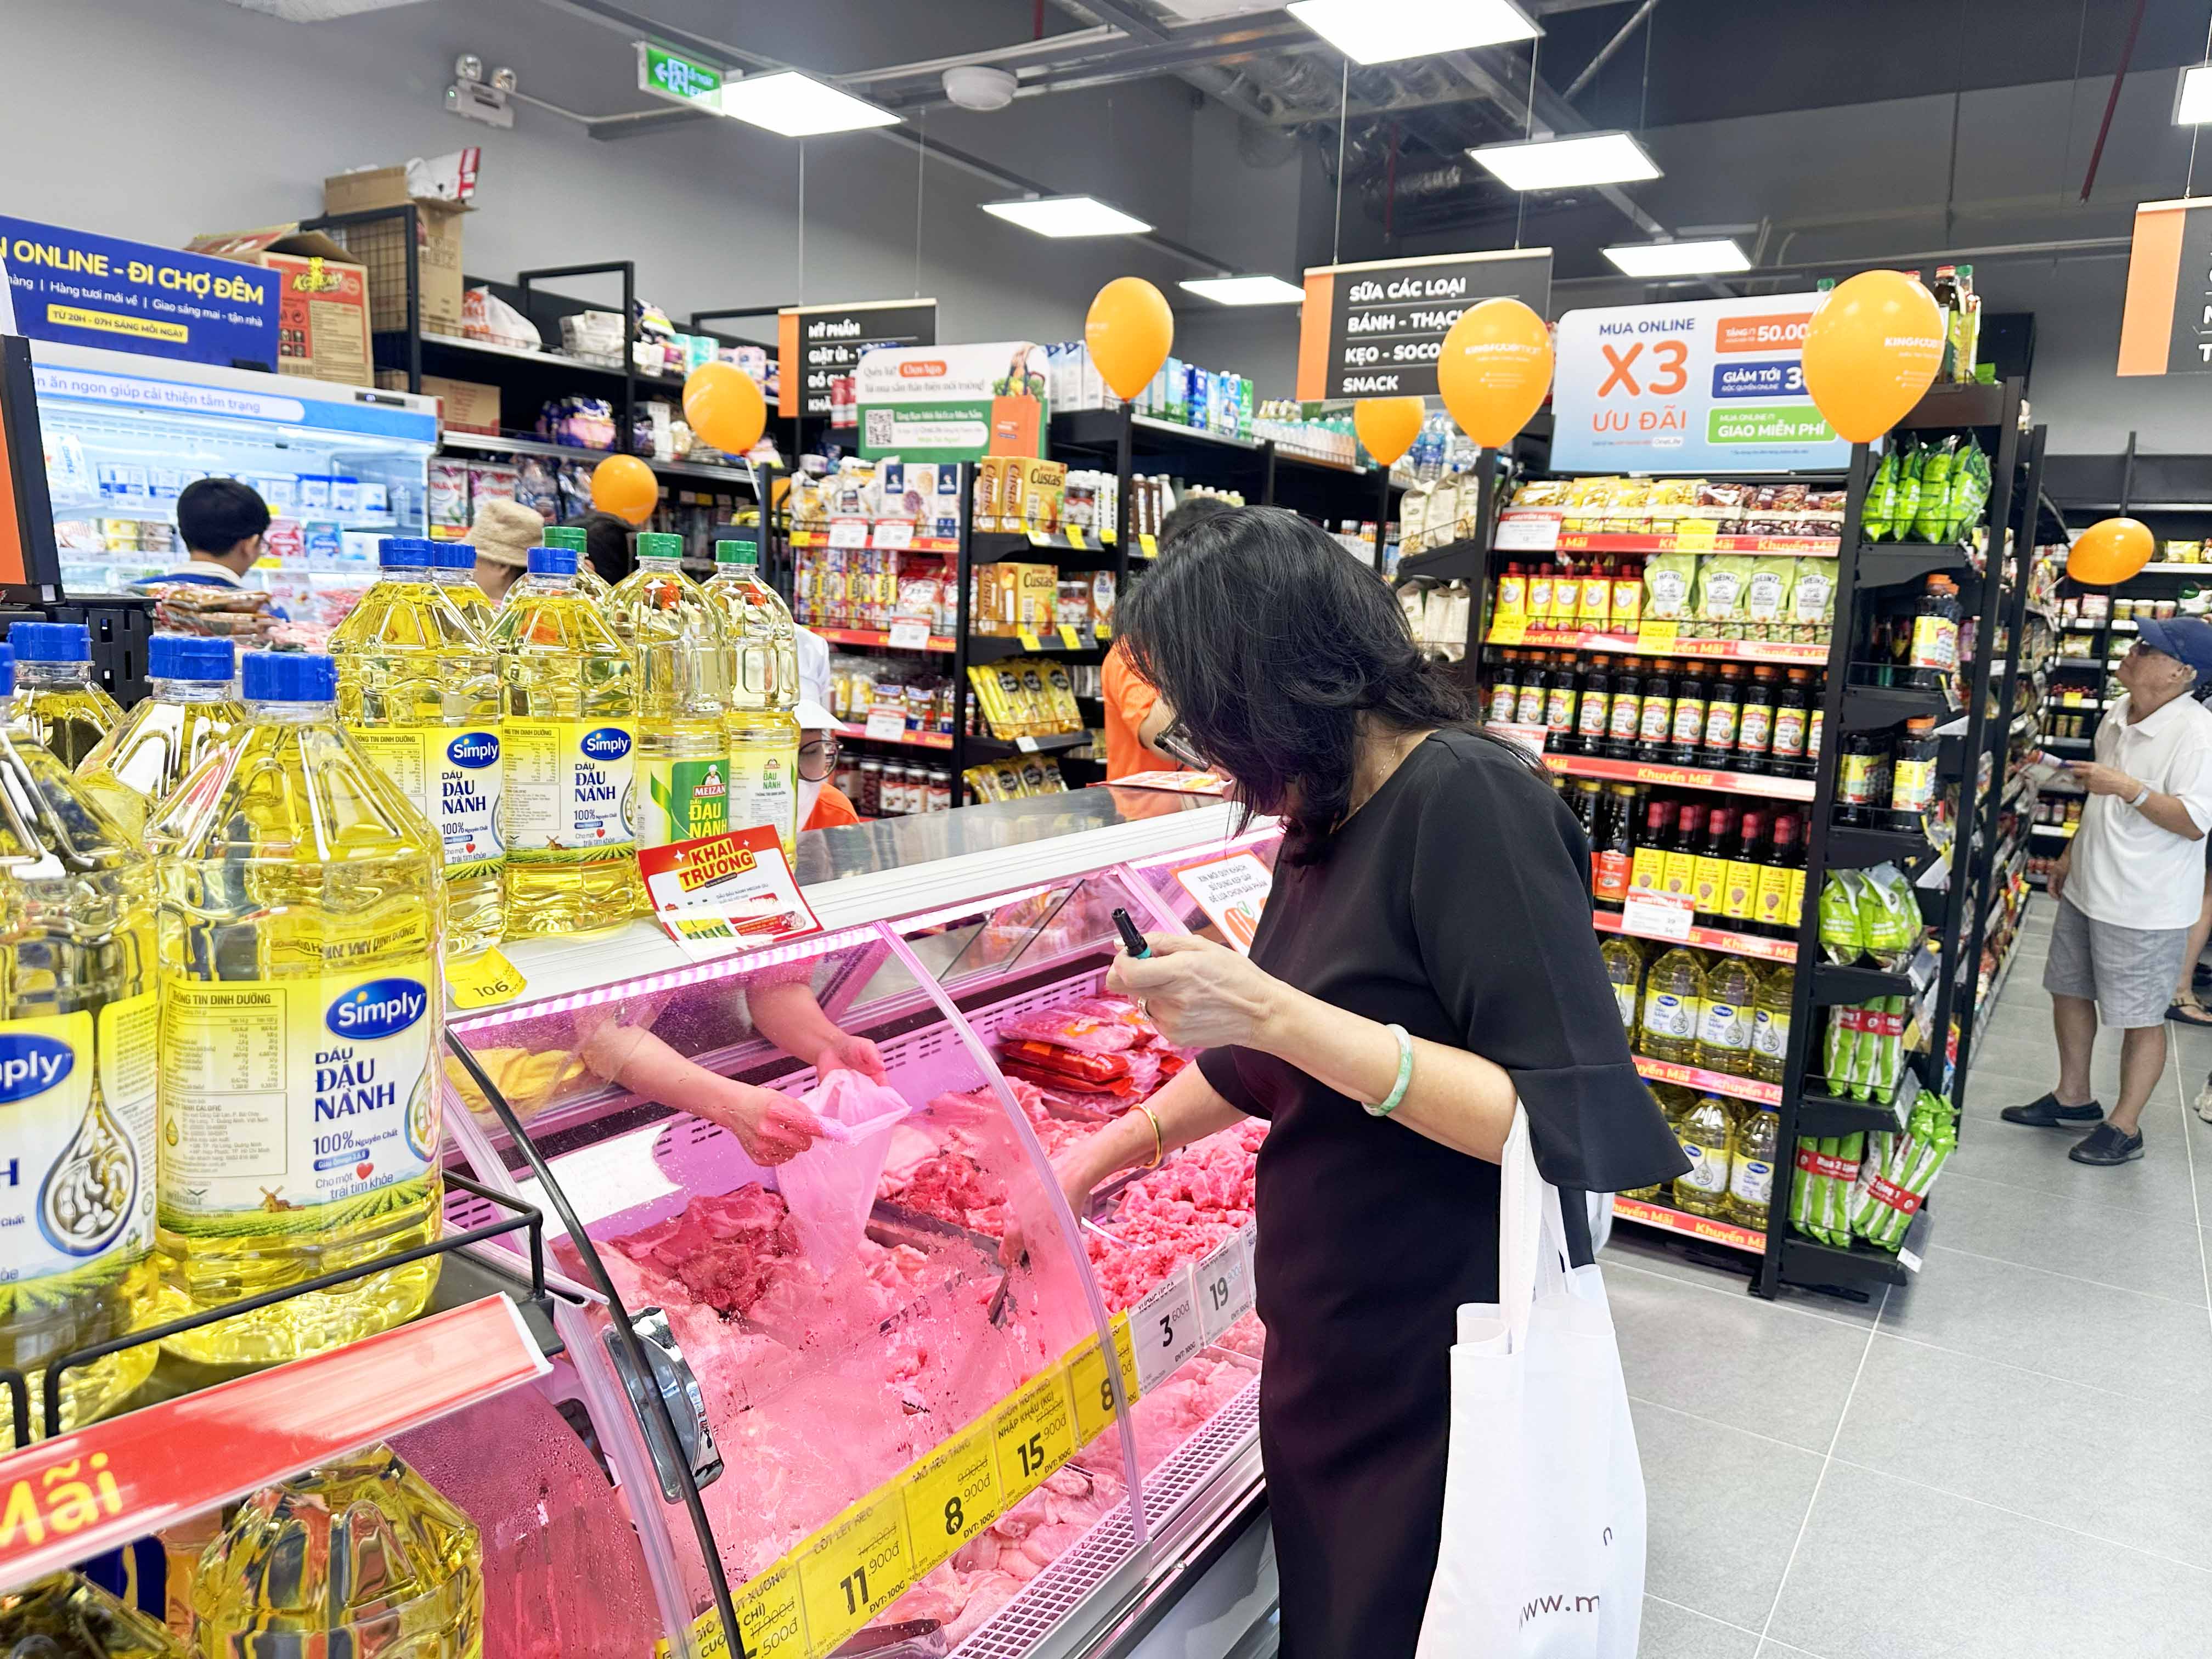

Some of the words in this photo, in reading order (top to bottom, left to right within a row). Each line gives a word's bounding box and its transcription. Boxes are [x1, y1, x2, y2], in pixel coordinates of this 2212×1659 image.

[14, 240, 109, 276] ONLINE
[127, 261, 154, 285] ĐI
[158, 267, 211, 300] CHỢ
[213, 275, 263, 306] ĐÊM
[50, 281, 80, 298] Hàng
[152, 298, 176, 312] Giao
[177, 303, 200, 318] sáng
[1350, 281, 1383, 302] SỮA
[1387, 277, 1423, 298] CÁC
[1426, 276, 1466, 298] LOẠI
[1347, 312, 1395, 332] BÁNH
[1409, 309, 1463, 330] THẠC
[1599, 323, 1633, 335] MUA
[1638, 318, 1695, 333] ONLINE
[1757, 323, 1808, 342] 50.00
[1345, 347, 1379, 366] KẸO
[1393, 342, 1441, 360] SOCO
[1598, 340, 1688, 397] X3
[1723, 368, 1756, 383] GIẢM
[1759, 367, 1781, 382] TỚI
[1785, 367, 1805, 390] 3
[1342, 375, 1398, 393] SNACK
[72, 382, 106, 395] ngon
[111, 385, 140, 400] giúp
[144, 388, 162, 400] cải
[165, 391, 198, 405] thiện
[228, 398, 261, 414] trạng
[1593, 409, 1629, 432] ƯU
[1639, 405, 1686, 430] ĐÃI
[1718, 424, 1755, 438] GIAO
[1758, 419, 1796, 437] MIỄN
[1798, 419, 1826, 436] PHÍ
[1031, 468, 1061, 487] Custas
[1565, 537, 1589, 548] Mãi
[1524, 632, 1552, 644] uyến
[454, 738, 498, 759] Simply
[586, 733, 628, 753] Simply
[1546, 758, 1568, 769] Mãi
[1637, 768, 1685, 783] Khuyến
[1688, 772, 1713, 785] Mãi
[442, 794, 486, 815] NÀNH
[575, 785, 616, 802] NÀNH
[574, 810, 595, 821] 100%
[688, 802, 721, 821] ĐẬU
[442, 822, 464, 835] 100%
[691, 840, 734, 866] KHAI
[679, 851, 753, 887] TRƯƠNG
[1775, 946, 1796, 958] Mã
[193, 995, 208, 1004] TIN
[211, 995, 234, 1005] DINH
[236, 992, 270, 1004] DƯỠNG
[473, 980, 509, 997] 106
[338, 991, 421, 1027] Simply
[0, 1049, 62, 1089] ply
[315, 1057, 375, 1092] ĐẬU
[1667, 1069, 1690, 1082] Mãi
[314, 1080, 396, 1122] NÀNH
[313, 1130, 354, 1155] 100%
[355, 1134, 381, 1148] Nguyên
[382, 1128, 398, 1141] Chất
[316, 1176, 335, 1189] Cho
[336, 1172, 353, 1186] một
[330, 1186, 348, 1200] trái
[351, 1181, 368, 1194] tim
[369, 1173, 393, 1189] khỏe
[1651, 1212, 1673, 1226] Mãi
[1695, 1222, 1744, 1245] Khuyến
[1210, 1277, 1228, 1311] 19
[1160, 1314, 1173, 1347] 3
[1017, 1432, 1044, 1477] 15
[945, 1496, 964, 1535] 8
[840, 1565, 869, 1615] 11
[888, 1580, 905, 1601] 100G
[701, 1630, 727, 1658] CUỘ
